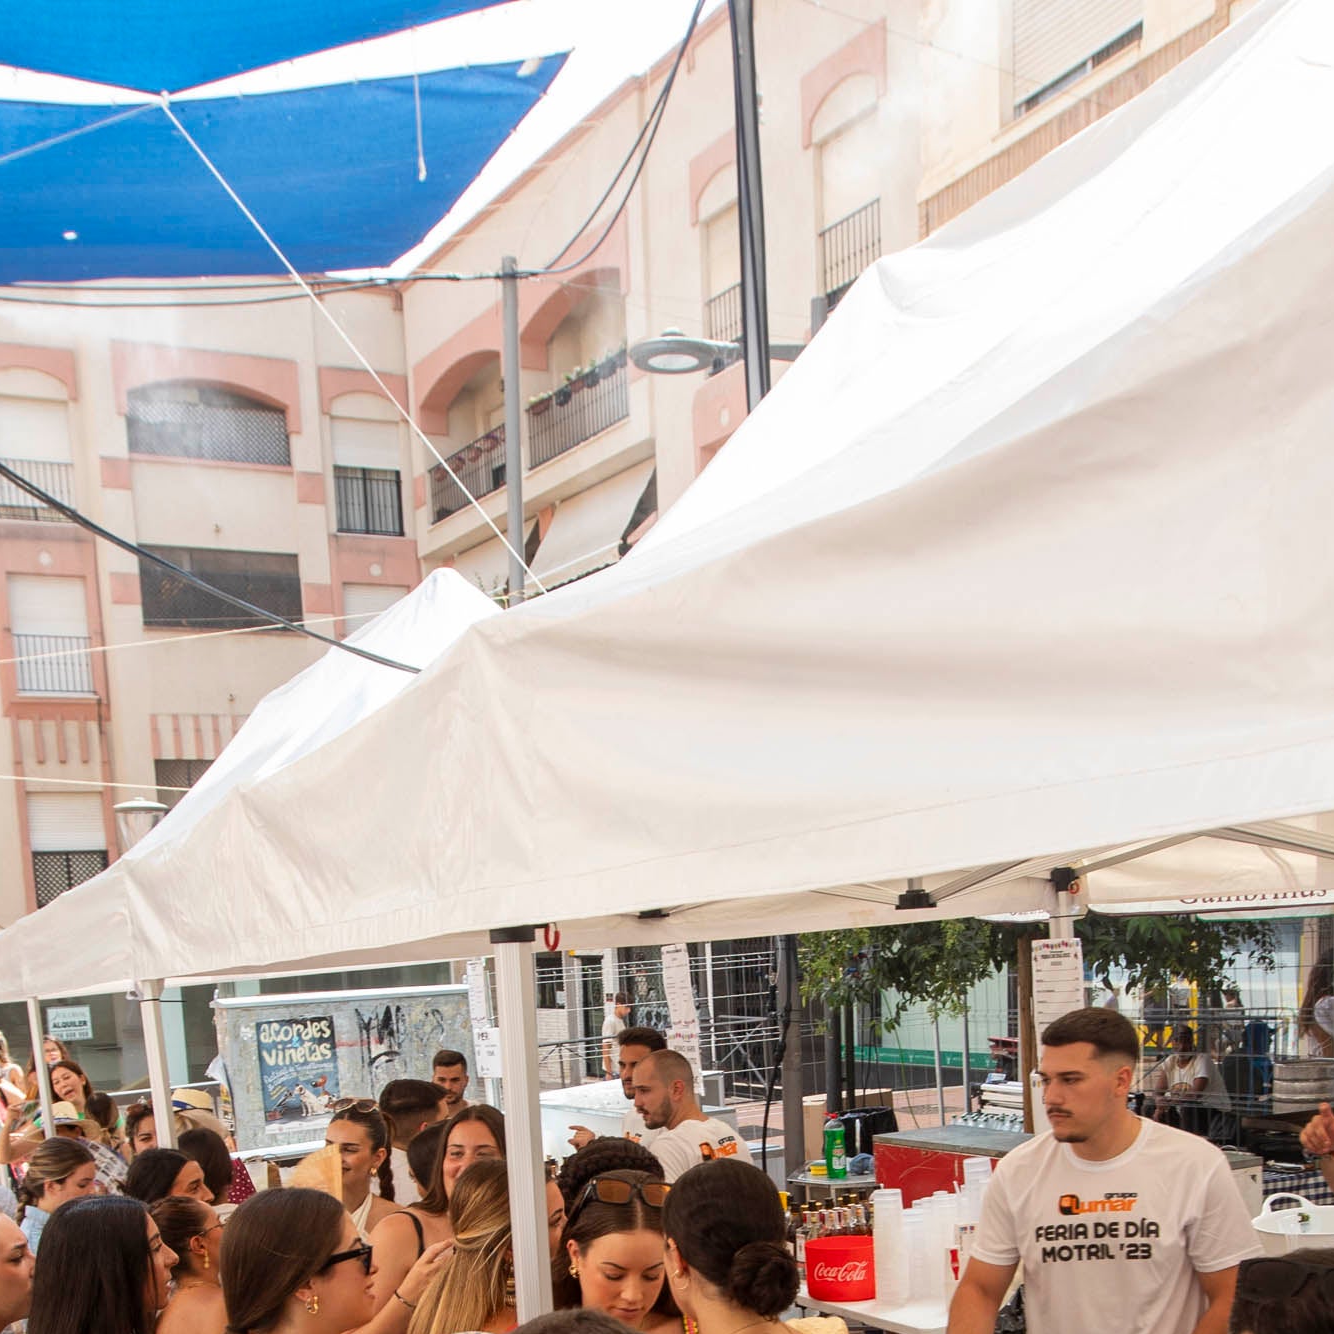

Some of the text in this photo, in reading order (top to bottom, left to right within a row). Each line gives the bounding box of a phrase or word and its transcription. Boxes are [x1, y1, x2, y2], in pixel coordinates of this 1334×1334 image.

[259, 1020, 332, 1043] acordes
[1035, 1217, 1160, 1242] FERIA DE DÍA
[1042, 1243, 1115, 1263] MOTRIL
[814, 1261, 868, 1282] Coca-Cola
